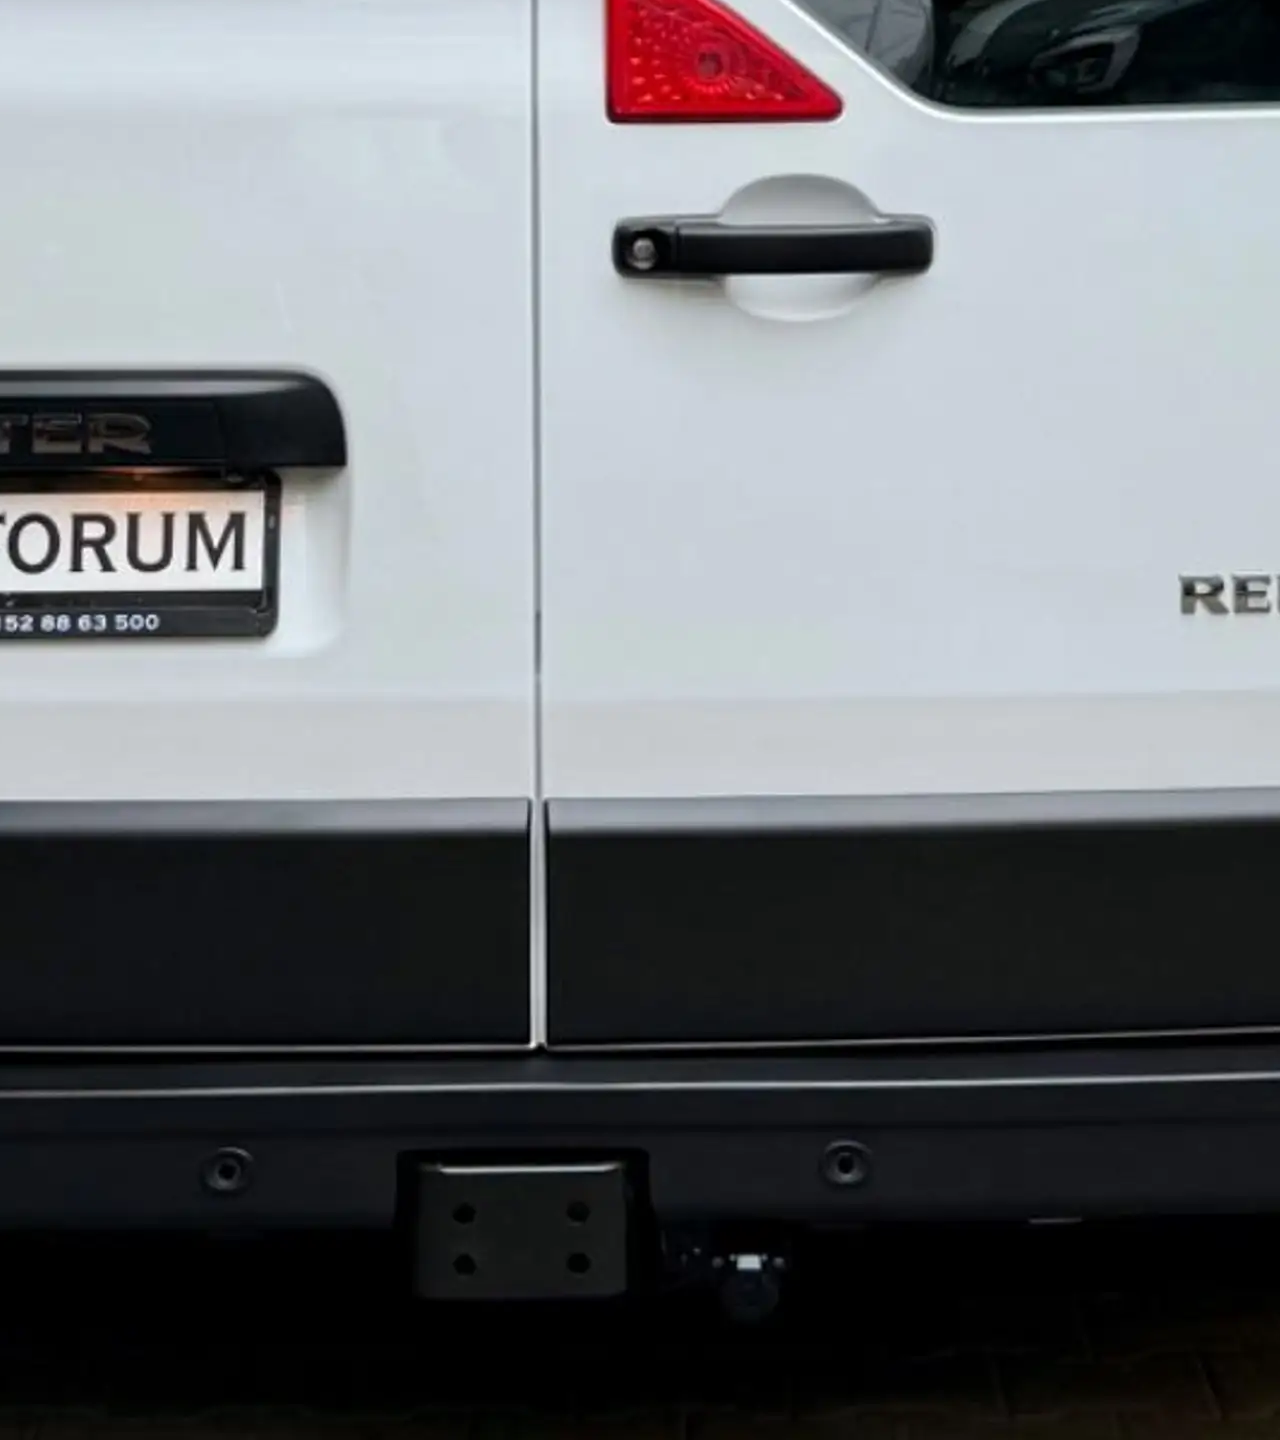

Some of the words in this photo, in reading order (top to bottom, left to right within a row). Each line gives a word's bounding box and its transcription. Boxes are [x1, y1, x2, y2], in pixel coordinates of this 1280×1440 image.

[40, 614, 72, 633] 88
[78, 614, 107, 632] 63
[114, 613, 160, 632] 500
